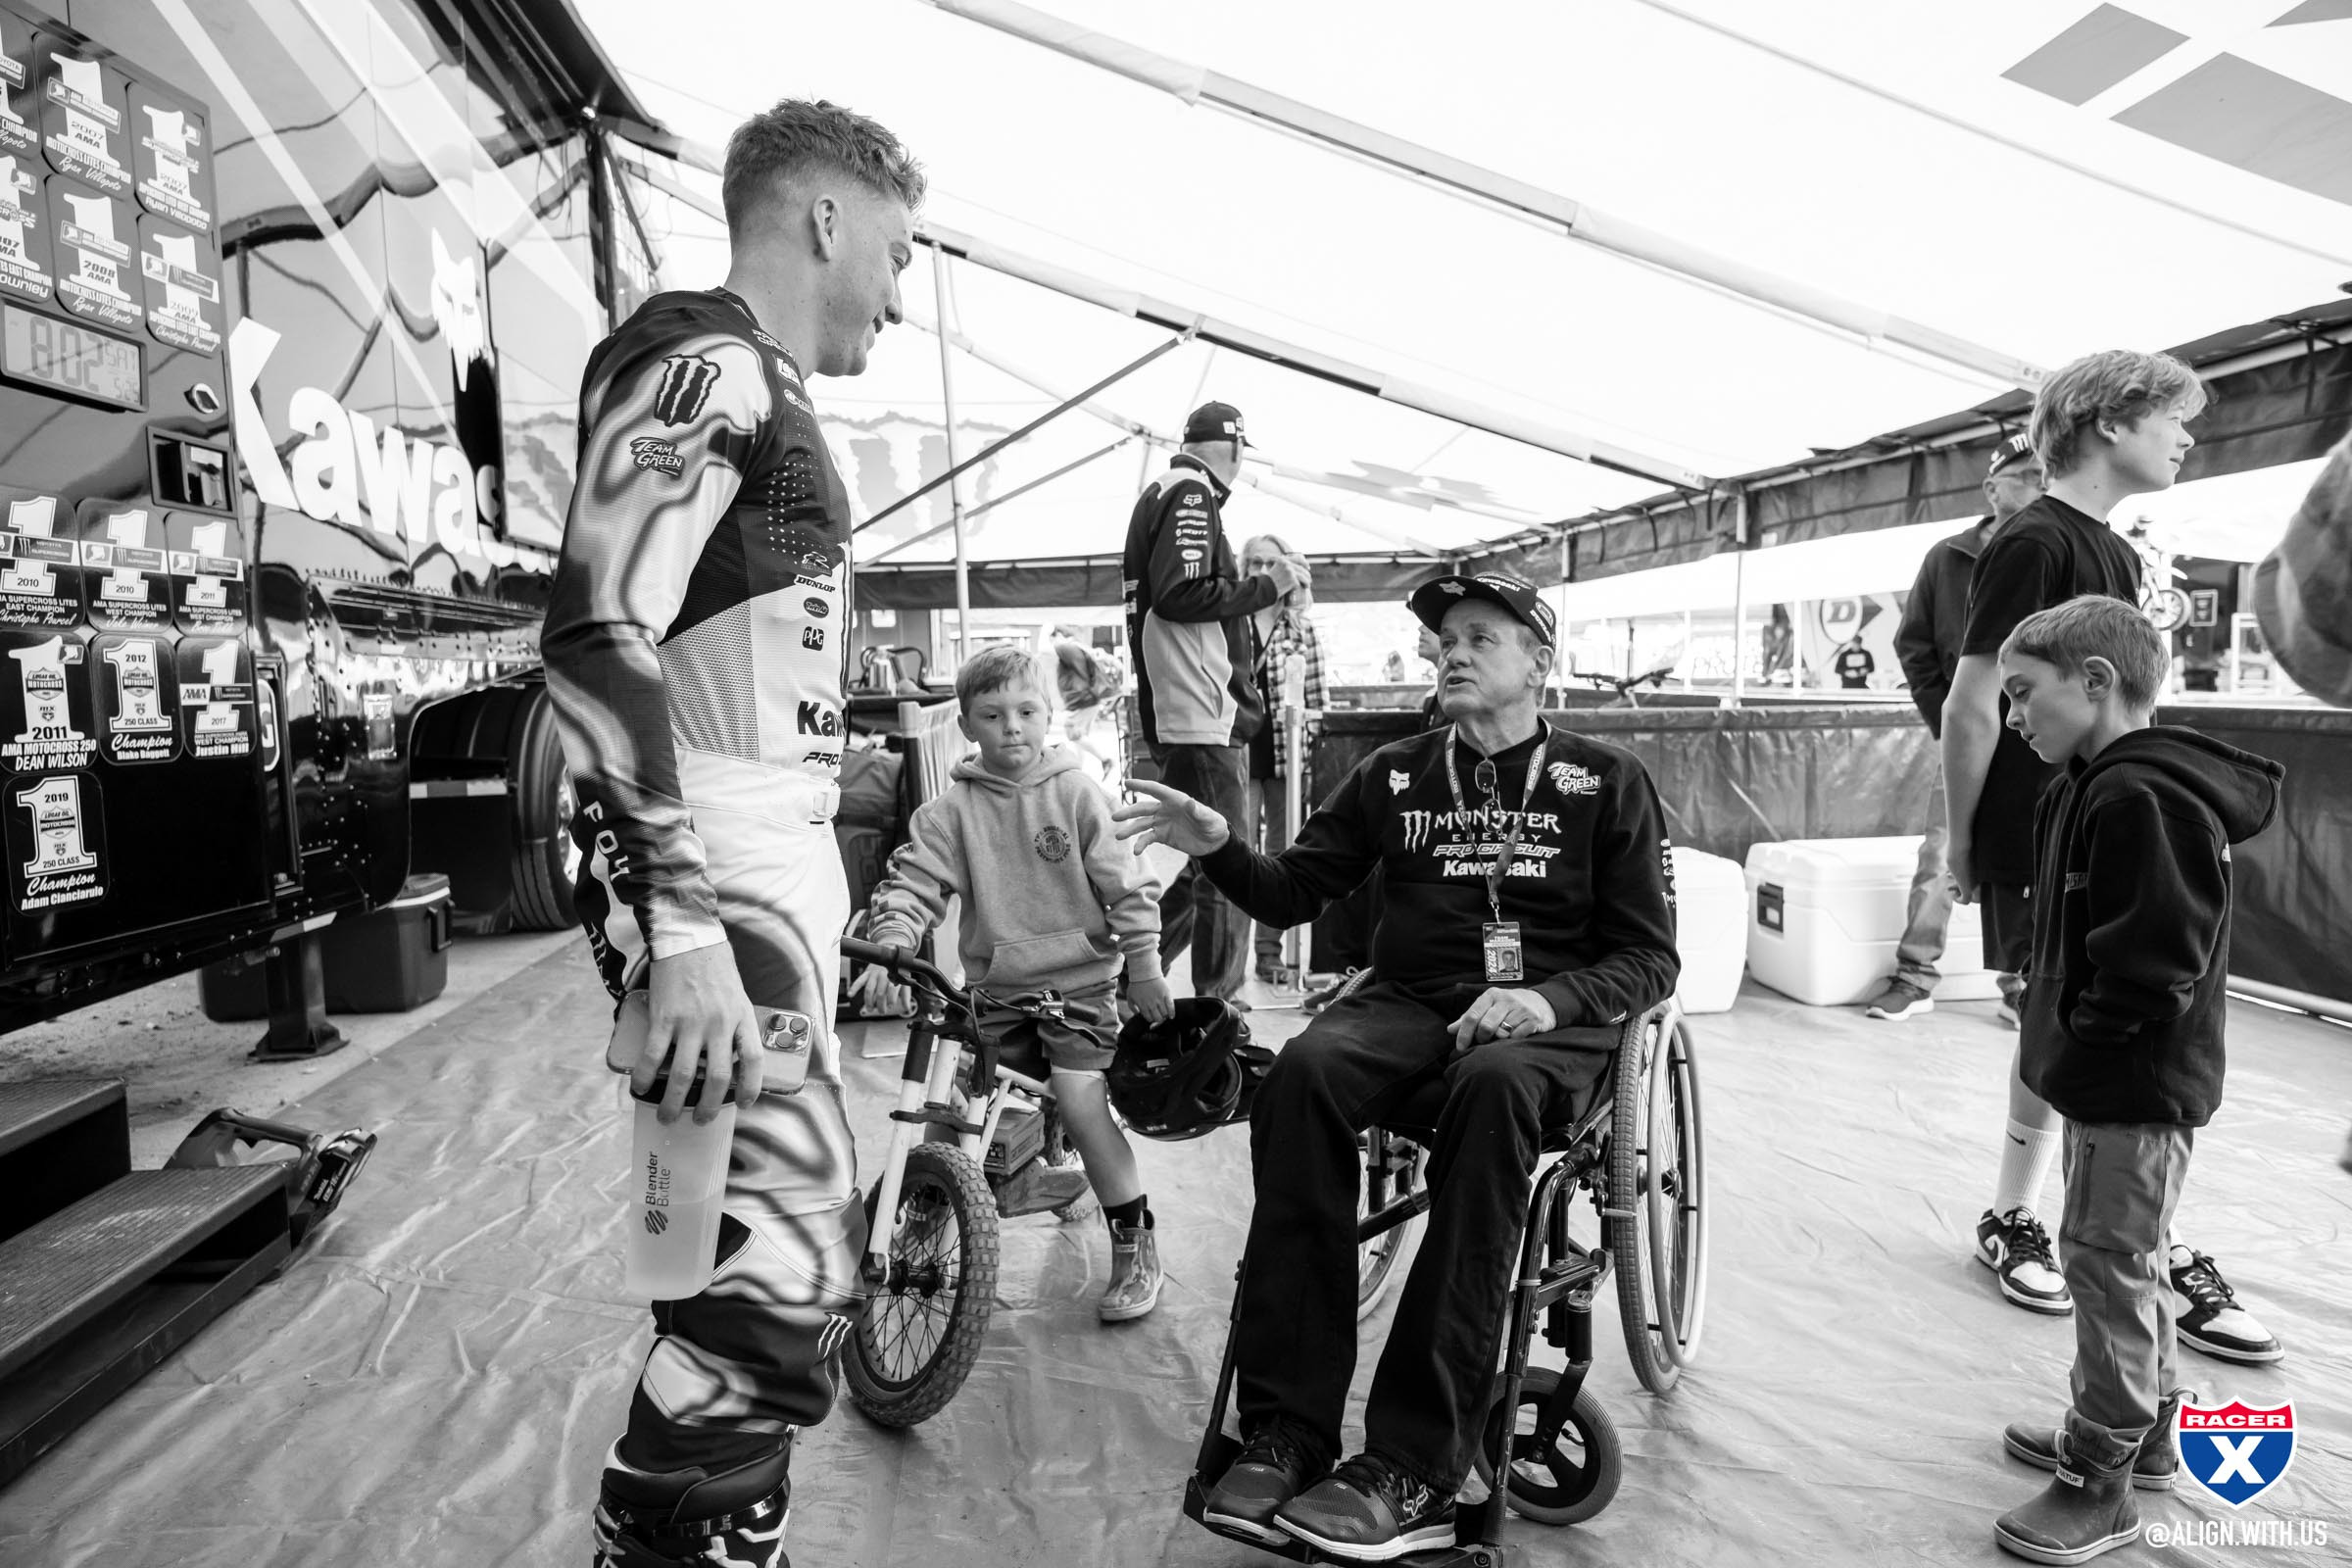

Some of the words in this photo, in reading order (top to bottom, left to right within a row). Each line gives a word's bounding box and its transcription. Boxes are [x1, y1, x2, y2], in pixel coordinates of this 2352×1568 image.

[74, 132, 101, 149] AMA
[87, 270, 112, 285] AMA
[0, 274, 48, 298] ownley
[631, 438, 676, 456] TEAM
[636, 452, 684, 469] GREEN
[18, 578, 39, 587] 2010
[116, 585, 134, 594] 2010
[795, 576, 836, 592] DUNLOP
[9, 595, 58, 606] SUPERCROSS
[109, 601, 150, 611] SUPERCROSS
[26, 605, 65, 613] CHAMPION
[105, 608, 122, 616] WEST
[124, 609, 157, 617] CHAMPION
[125, 654, 147, 662] 2012
[8, 635, 84, 743] 1
[103, 638, 172, 733] 1
[182, 689, 207, 699] AMA
[32, 726, 67, 740] 2011
[1, 743, 23, 757] AMA
[24, 740, 78, 756] MOTOCROSS
[80, 739, 96, 752] 250
[112, 734, 172, 752] Champion
[195, 745, 229, 757] Justin
[230, 743, 249, 755] Hill
[15, 755, 45, 771] DEAN
[47, 752, 88, 768] WILSON
[117, 751, 139, 760] Blake
[1547, 763, 1588, 779] TEAM
[1557, 775, 1600, 793] GREEN
[44, 793, 69, 804] 2019
[16, 775, 97, 878] 1
[1434, 806, 1562, 834] MONSTER
[1432, 844, 1476, 858] PRO
[43, 858, 57, 868] 250
[57, 856, 80, 866] CLASS
[26, 873, 96, 897] Champion
[22, 897, 49, 910] Adam
[645, 1151, 660, 1206] Blender
[657, 1167, 671, 1207] Bottle
